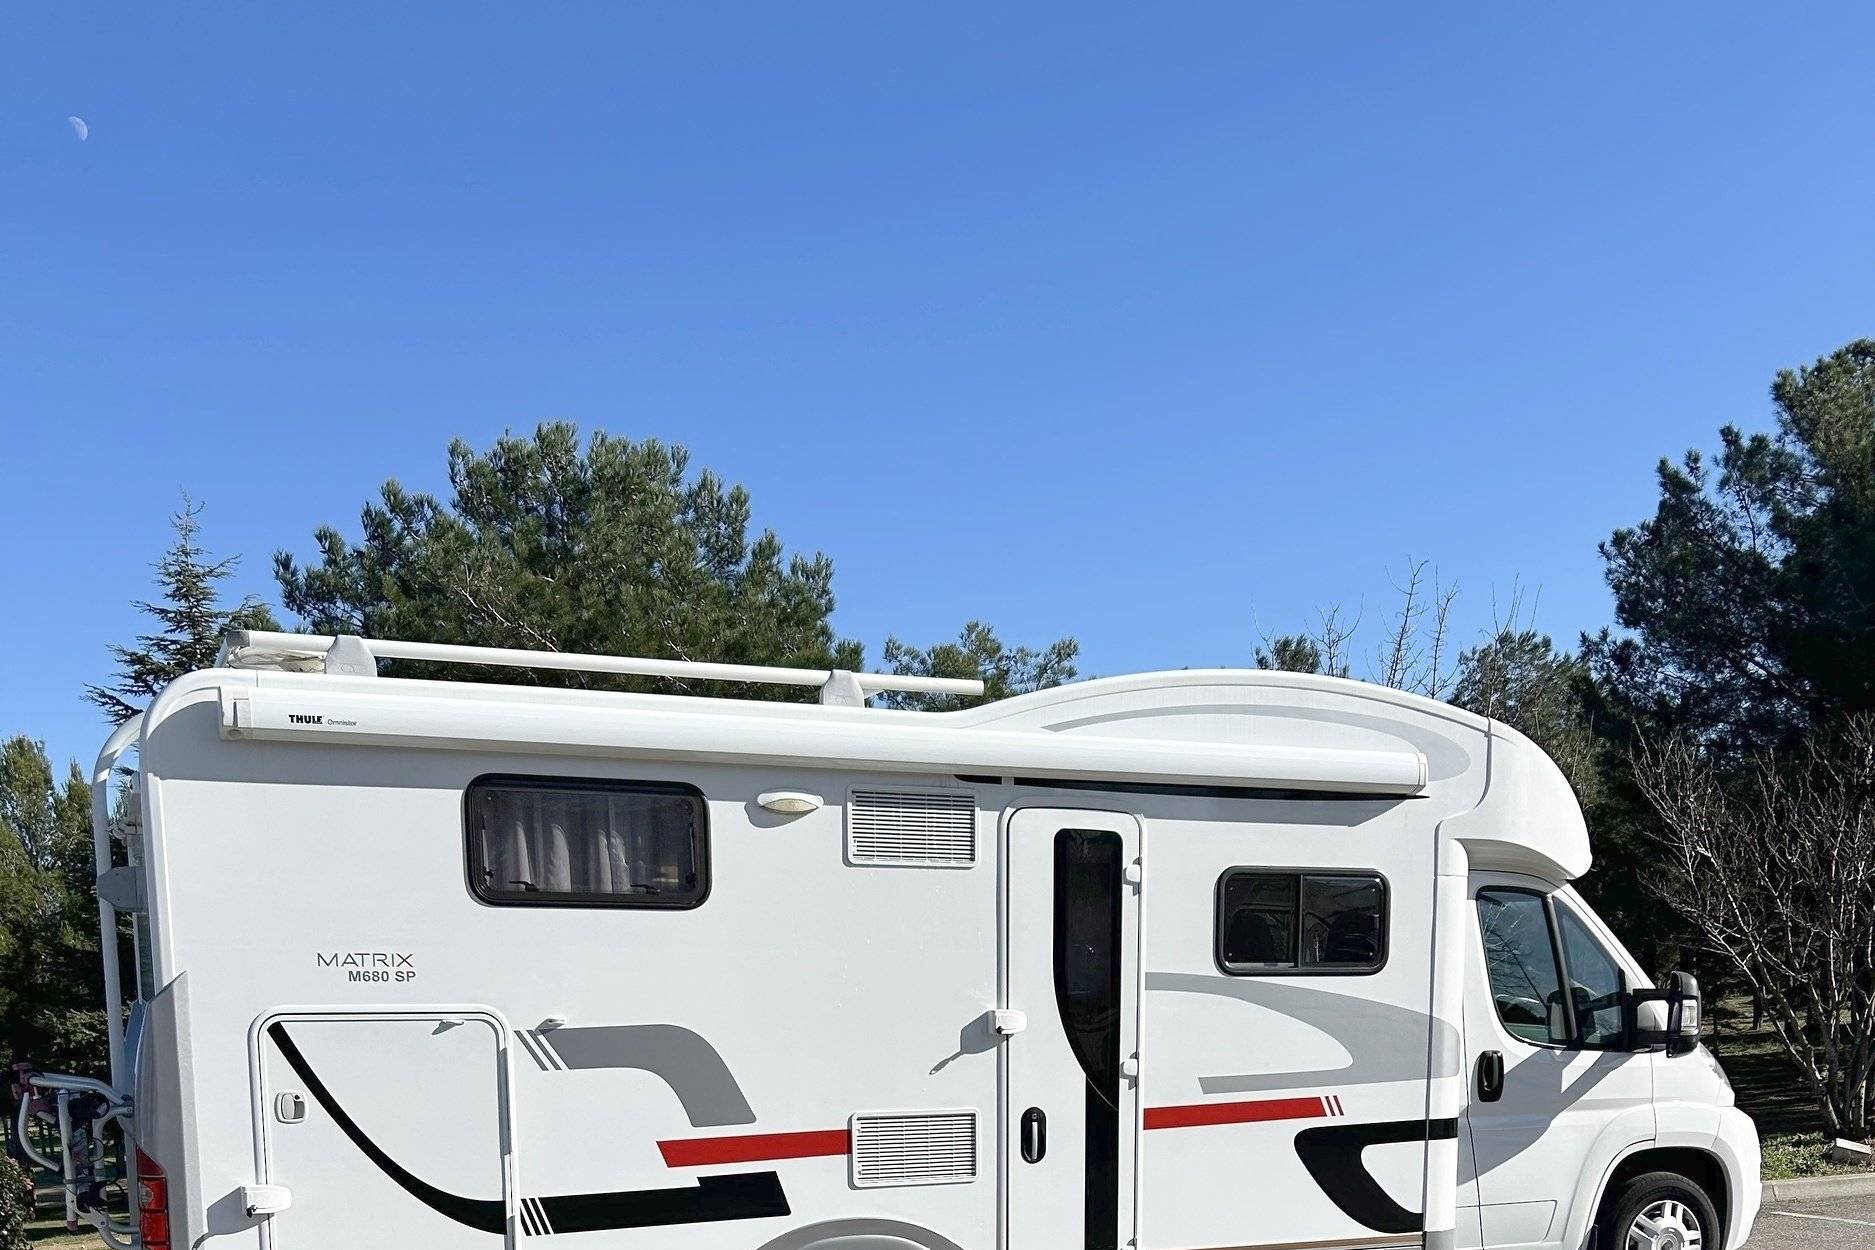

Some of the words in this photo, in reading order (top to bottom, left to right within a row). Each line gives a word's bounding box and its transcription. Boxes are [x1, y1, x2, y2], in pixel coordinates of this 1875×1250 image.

[288, 714, 323, 725] THULE
[317, 952, 414, 968] MATRIX
[348, 970, 390, 982] M680
[395, 970, 416, 982] SP
